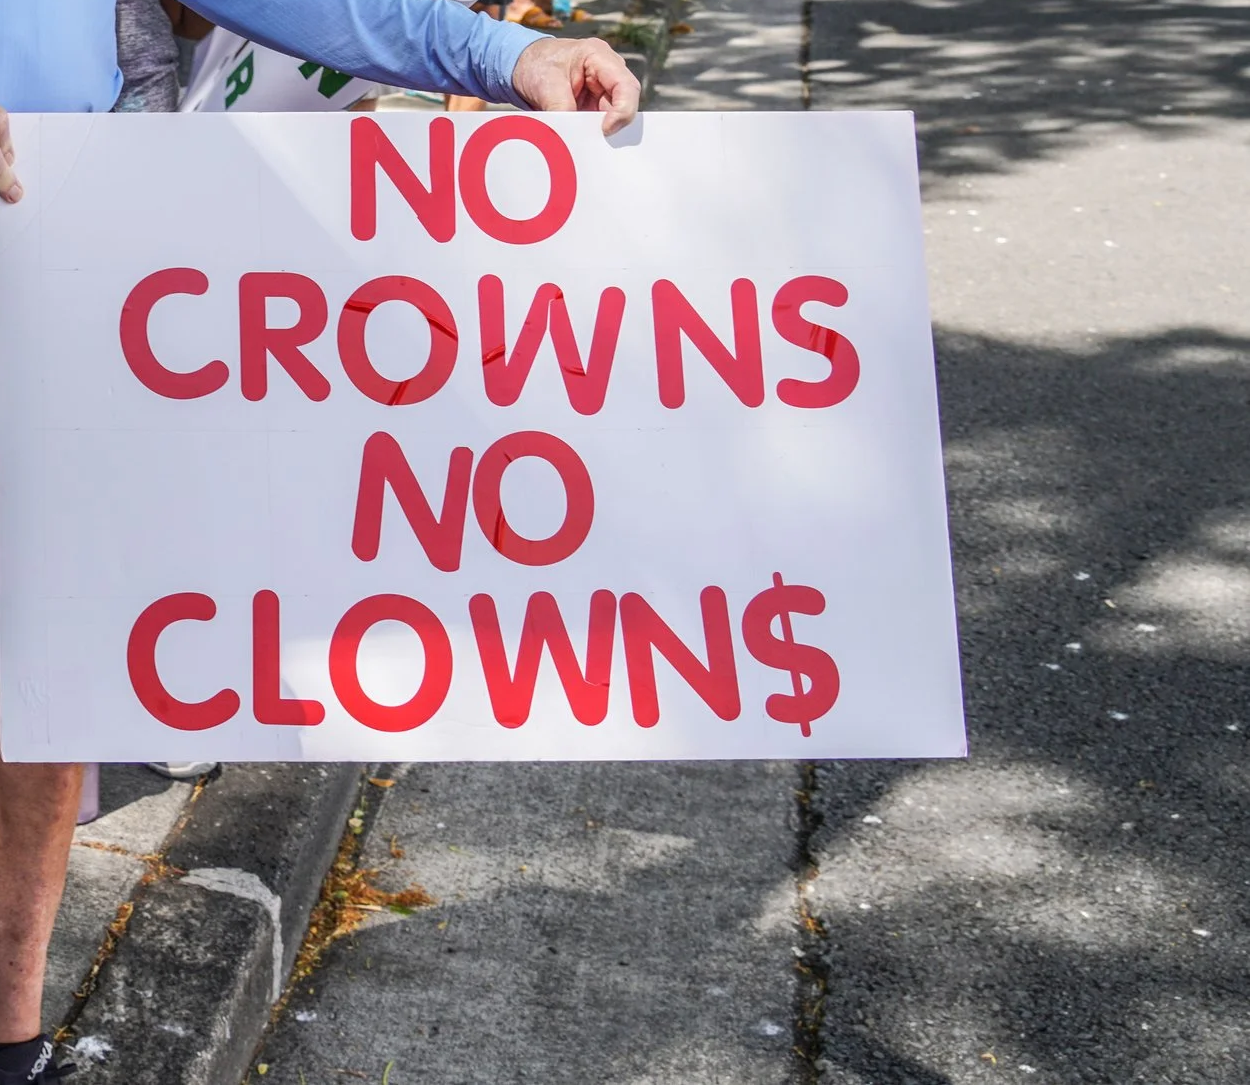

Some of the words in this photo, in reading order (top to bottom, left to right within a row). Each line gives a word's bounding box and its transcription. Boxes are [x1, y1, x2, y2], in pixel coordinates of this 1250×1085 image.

[350, 115, 578, 245] NO
[119, 267, 861, 417] CROWNS
[351, 430, 596, 573] NO
[126, 570, 841, 738] CLOWN$
